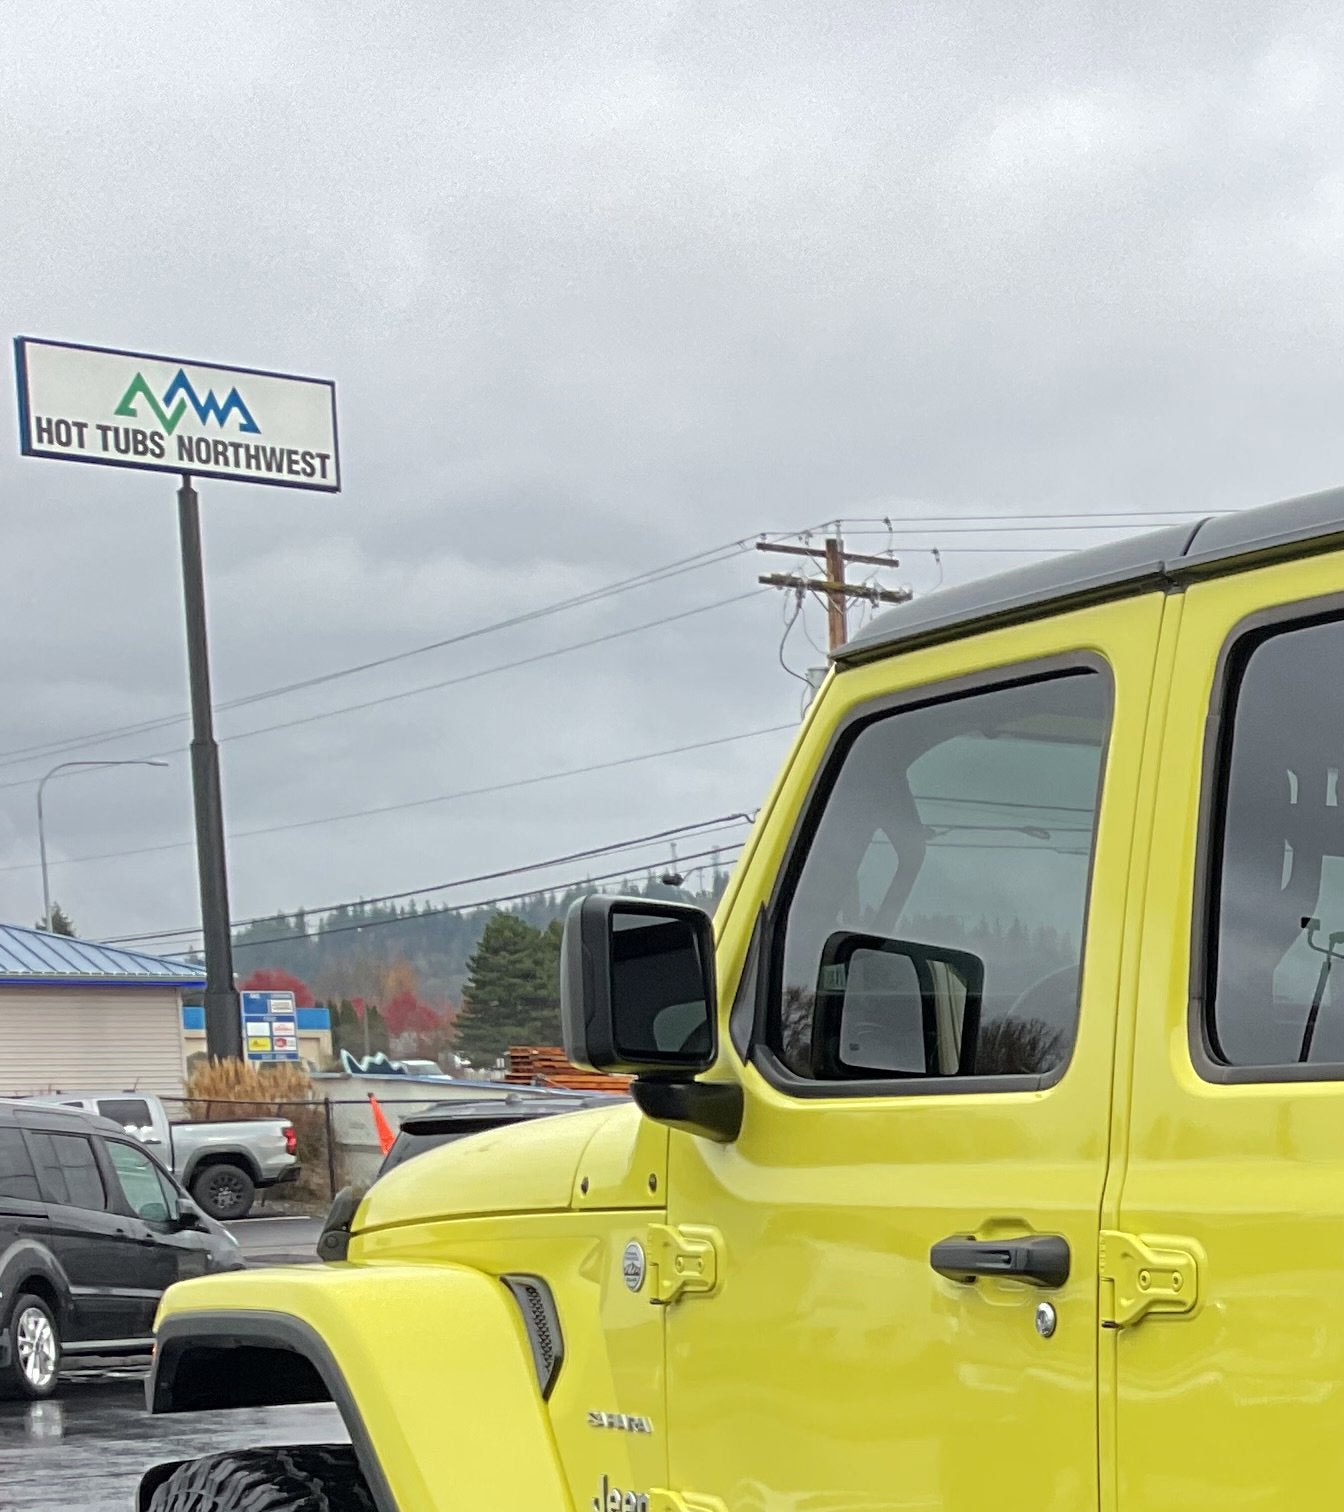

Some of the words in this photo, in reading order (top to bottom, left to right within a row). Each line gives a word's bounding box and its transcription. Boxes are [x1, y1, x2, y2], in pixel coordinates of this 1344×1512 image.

[36, 416, 88, 449] HOT
[96, 424, 165, 460] TUBS
[177, 435, 330, 480] NORTHWEST
[588, 1411, 653, 1433] SAHARA
